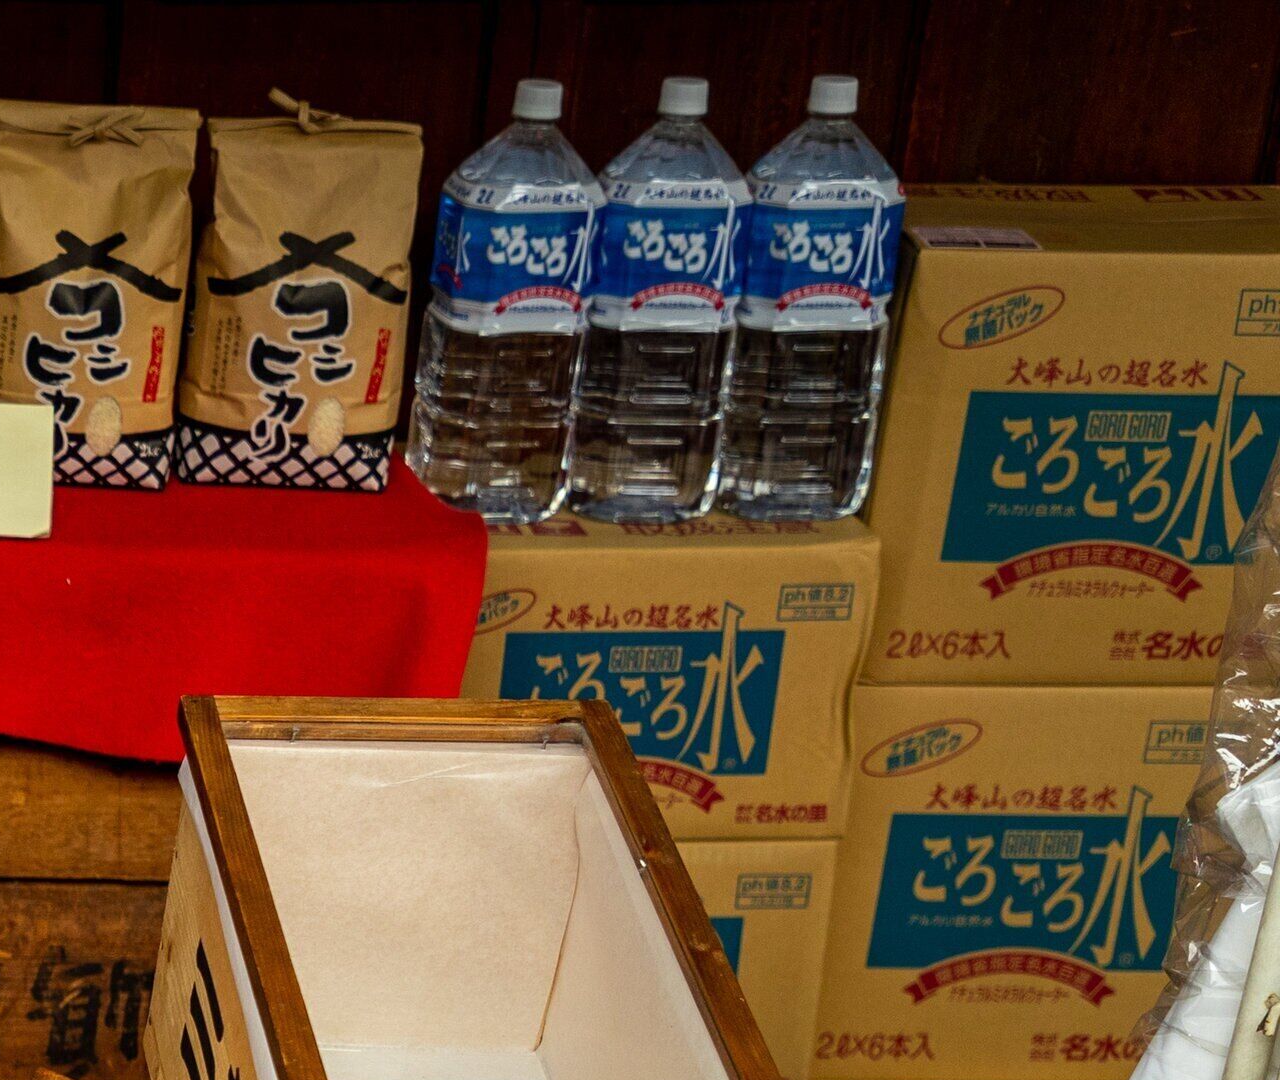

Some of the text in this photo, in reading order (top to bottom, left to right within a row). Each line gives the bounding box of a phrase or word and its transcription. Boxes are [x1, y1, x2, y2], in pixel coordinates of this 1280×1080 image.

[486, 203, 599, 293] ごろごろ水
[623, 199, 742, 291] ごろごろ水
[769, 196, 891, 290] ごろごろ水
[1247, 294, 1280, 317] ph
[249, 281, 354, 460] コシヒカリ
[1005, 355, 1210, 388] 大峰山の超名水
[991, 360, 1264, 561] ごろごろ水
[543, 603, 721, 630] 大峰山の超名水
[924, 783, 1120, 813] 大峰山の超名水
[911, 785, 1173, 967] ごろごろ水
